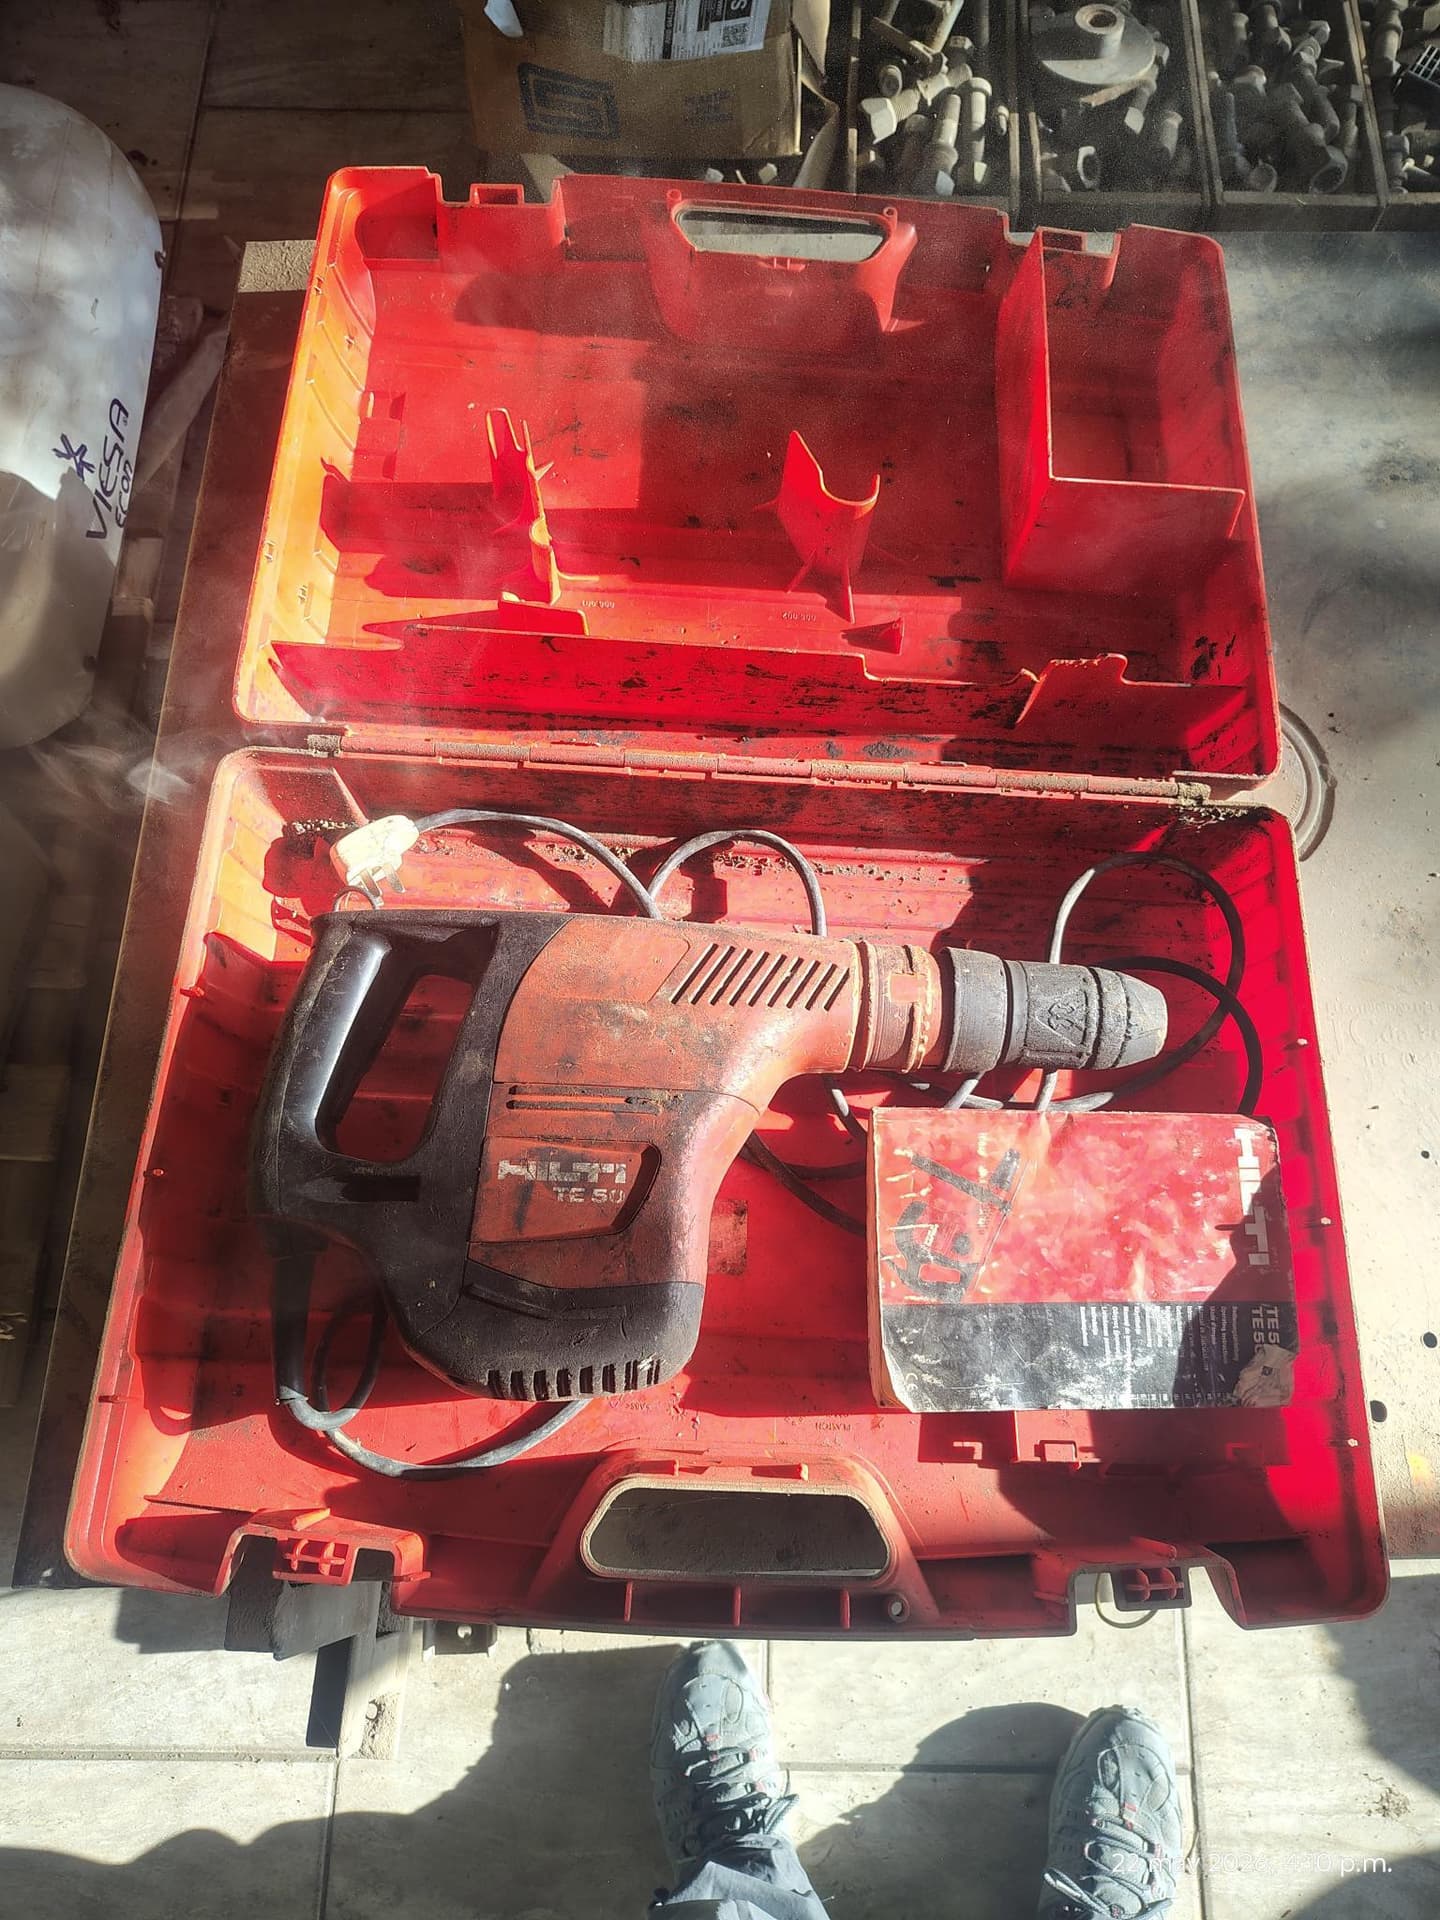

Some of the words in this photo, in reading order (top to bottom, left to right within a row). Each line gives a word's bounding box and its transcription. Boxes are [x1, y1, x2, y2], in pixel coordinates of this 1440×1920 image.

[86, 398, 129, 539] VIESA
[498, 1159, 627, 1184] HILTI
[553, 1187, 586, 1203] TE
[591, 1187, 626, 1204] 50
[1234, 1127, 1271, 1266] HILTI
[1251, 1306, 1264, 1329] TE
[1266, 1306, 1280, 1329] TE
